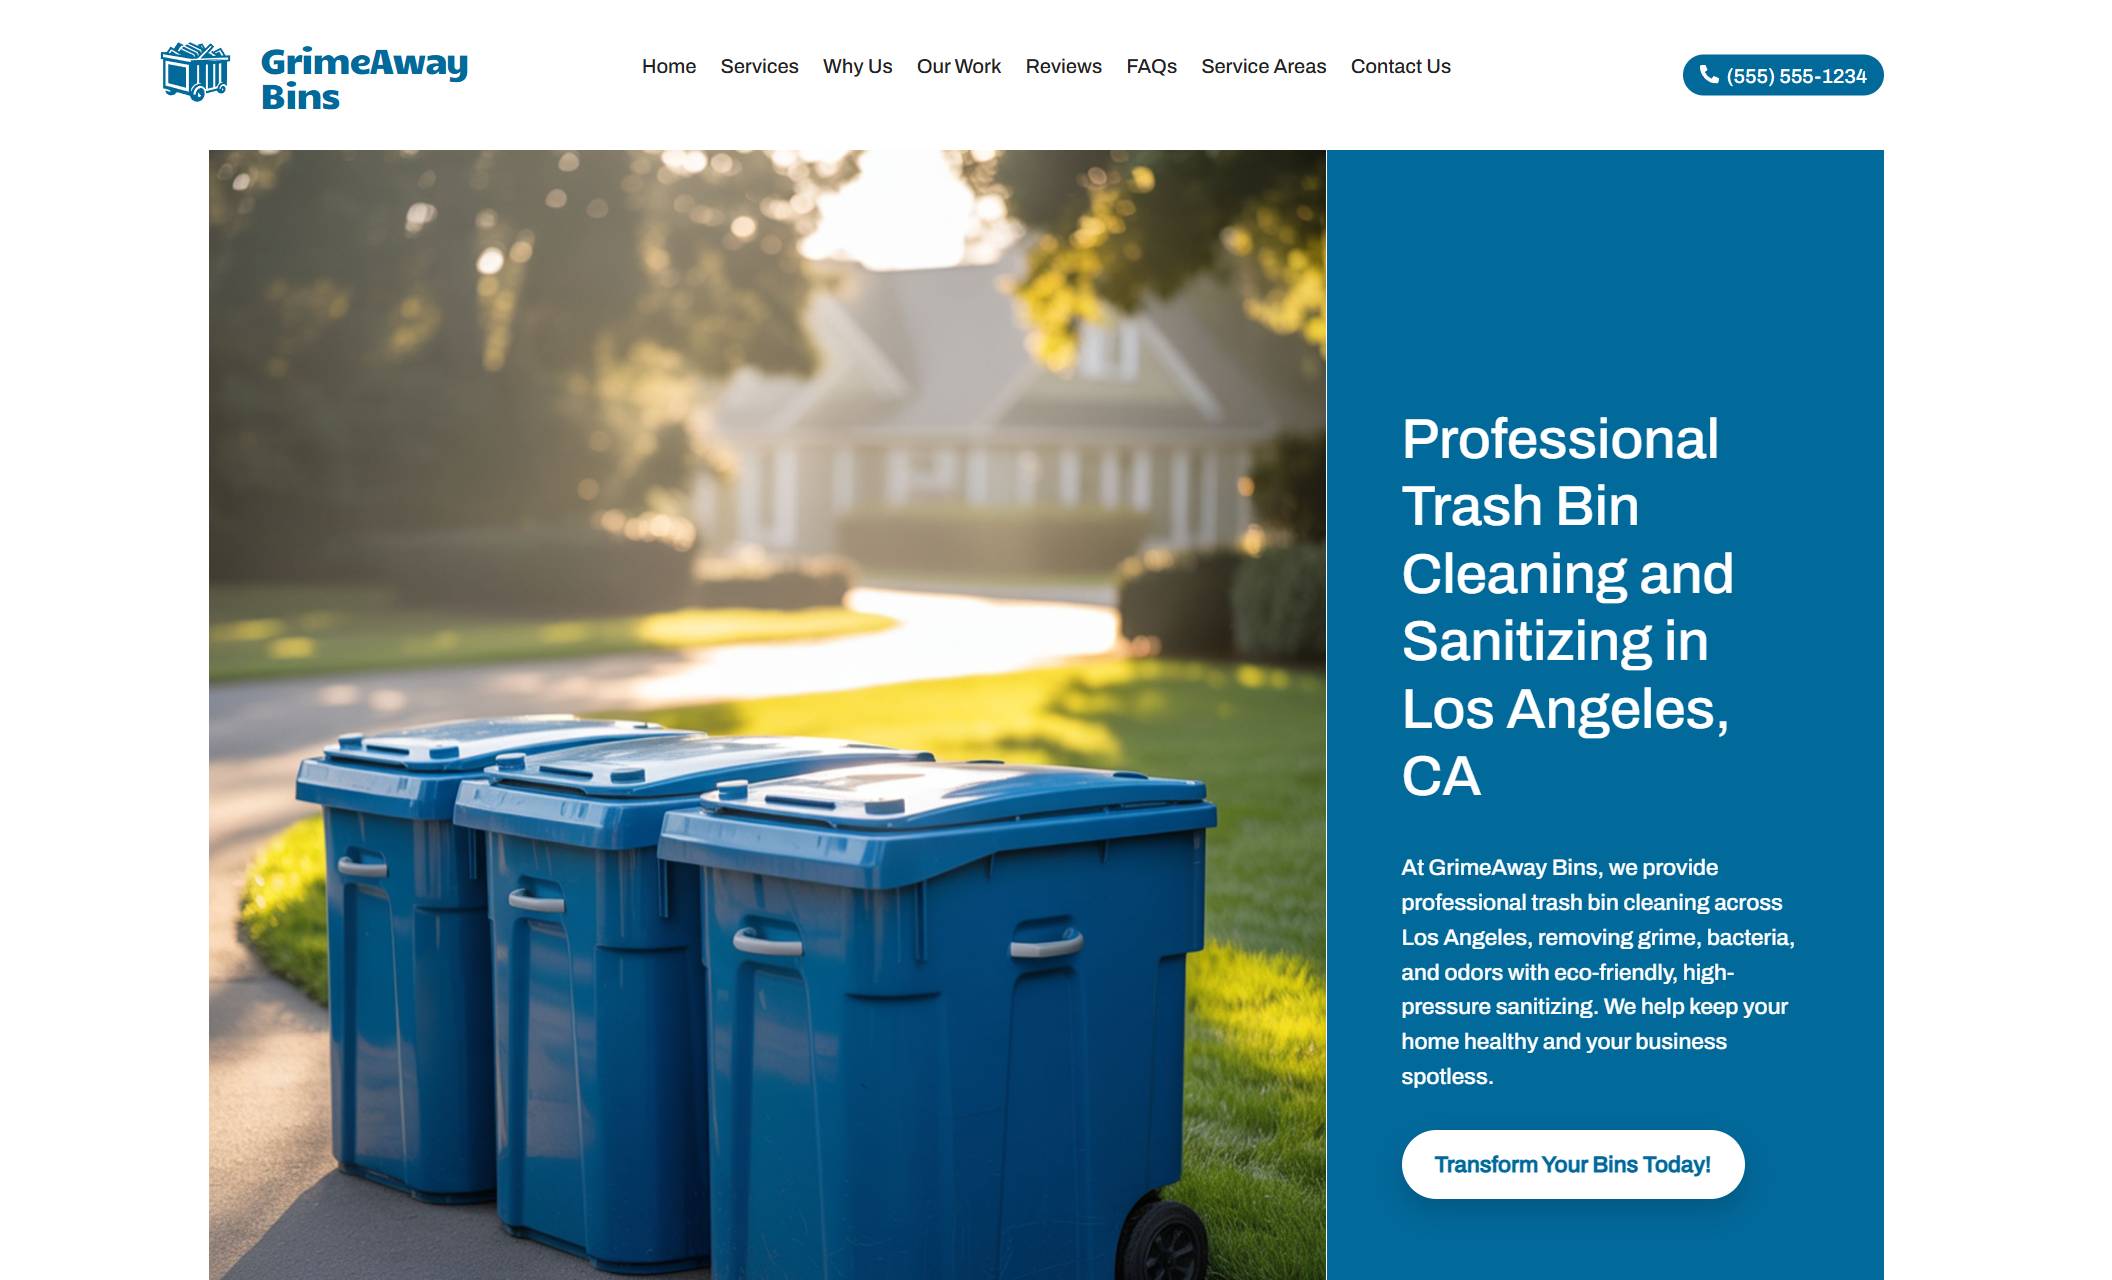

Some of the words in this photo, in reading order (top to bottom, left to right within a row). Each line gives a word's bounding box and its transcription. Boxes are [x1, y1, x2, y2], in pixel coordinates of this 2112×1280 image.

[261, 45, 469, 84] GrimeAway
[642, 58, 697, 74] Home
[720, 57, 799, 74] Services
[822, 58, 864, 78] Why
[868, 58, 893, 74] Us
[917, 58, 952, 74] Our
[954, 57, 1002, 74] Work
[1026, 57, 1103, 74] Reviews
[1127, 58, 1178, 77] FAQs
[1201, 57, 1270, 74] Service
[1273, 58, 1327, 74] Areas
[1351, 58, 1423, 74] Contact
[1427, 58, 1452, 74] Us
[1727, 67, 1775, 87] (555)
[1779, 68, 1868, 85] 555-1234
[261, 80, 341, 111] Bins
[1404, 415, 1718, 460] Professional
[1401, 483, 1542, 527] Trash
[1558, 483, 1638, 526] Bin
[1403, 551, 1629, 605] Cleaning
[1640, 551, 1733, 595] and
[1403, 618, 1654, 672] Sanitizing
[1666, 618, 1708, 661] in
[1404, 688, 1494, 730] Los
[1505, 686, 1728, 740] Angeles,
[1402, 754, 1482, 797] CA
[1400, 858, 1425, 877] At
[1428, 857, 1548, 880] GrimeAway
[1552, 857, 1604, 880] Bins,
[1608, 862, 1639, 877] we
[1642, 857, 1719, 880] provide
[1401, 892, 1527, 915] professional
[1530, 893, 1583, 912] trash
[1587, 893, 1619, 912] bin
[1623, 893, 1711, 915] cleaning
[1714, 897, 1783, 912] across
[1402, 928, 1440, 947] Los
[1442, 927, 1533, 950] Angeles,
[1538, 927, 1634, 950] removing
[1637, 928, 1702, 950] grime,
[1707, 927, 1795, 950] bacteria,
[1401, 962, 1440, 982] and
[1444, 963, 1504, 982] odors
[1507, 962, 1550, 982] with
[1553, 962, 1678, 985] eco-friendly,
[1683, 962, 1735, 985] high-
[1401, 1001, 1492, 1019] pressure
[1495, 996, 1599, 1019] sanitizing.
[1603, 997, 1637, 1015] We
[1641, 996, 1686, 1019] help
[1689, 996, 1739, 1019] keep
[1742, 1001, 1790, 1019] your
[1401, 1031, 1460, 1051] home
[1464, 1031, 1540, 1054] healthy
[1542, 1031, 1581, 1051] and
[1585, 1036, 1633, 1054] your
[1635, 1031, 1728, 1051] business
[1401, 1066, 1494, 1089] spotless.
[1434, 1154, 1539, 1174] Transform
[1540, 1154, 1590, 1174] Your
[1593, 1154, 1639, 1174] Bins
[1642, 1154, 1711, 1178] Today!
